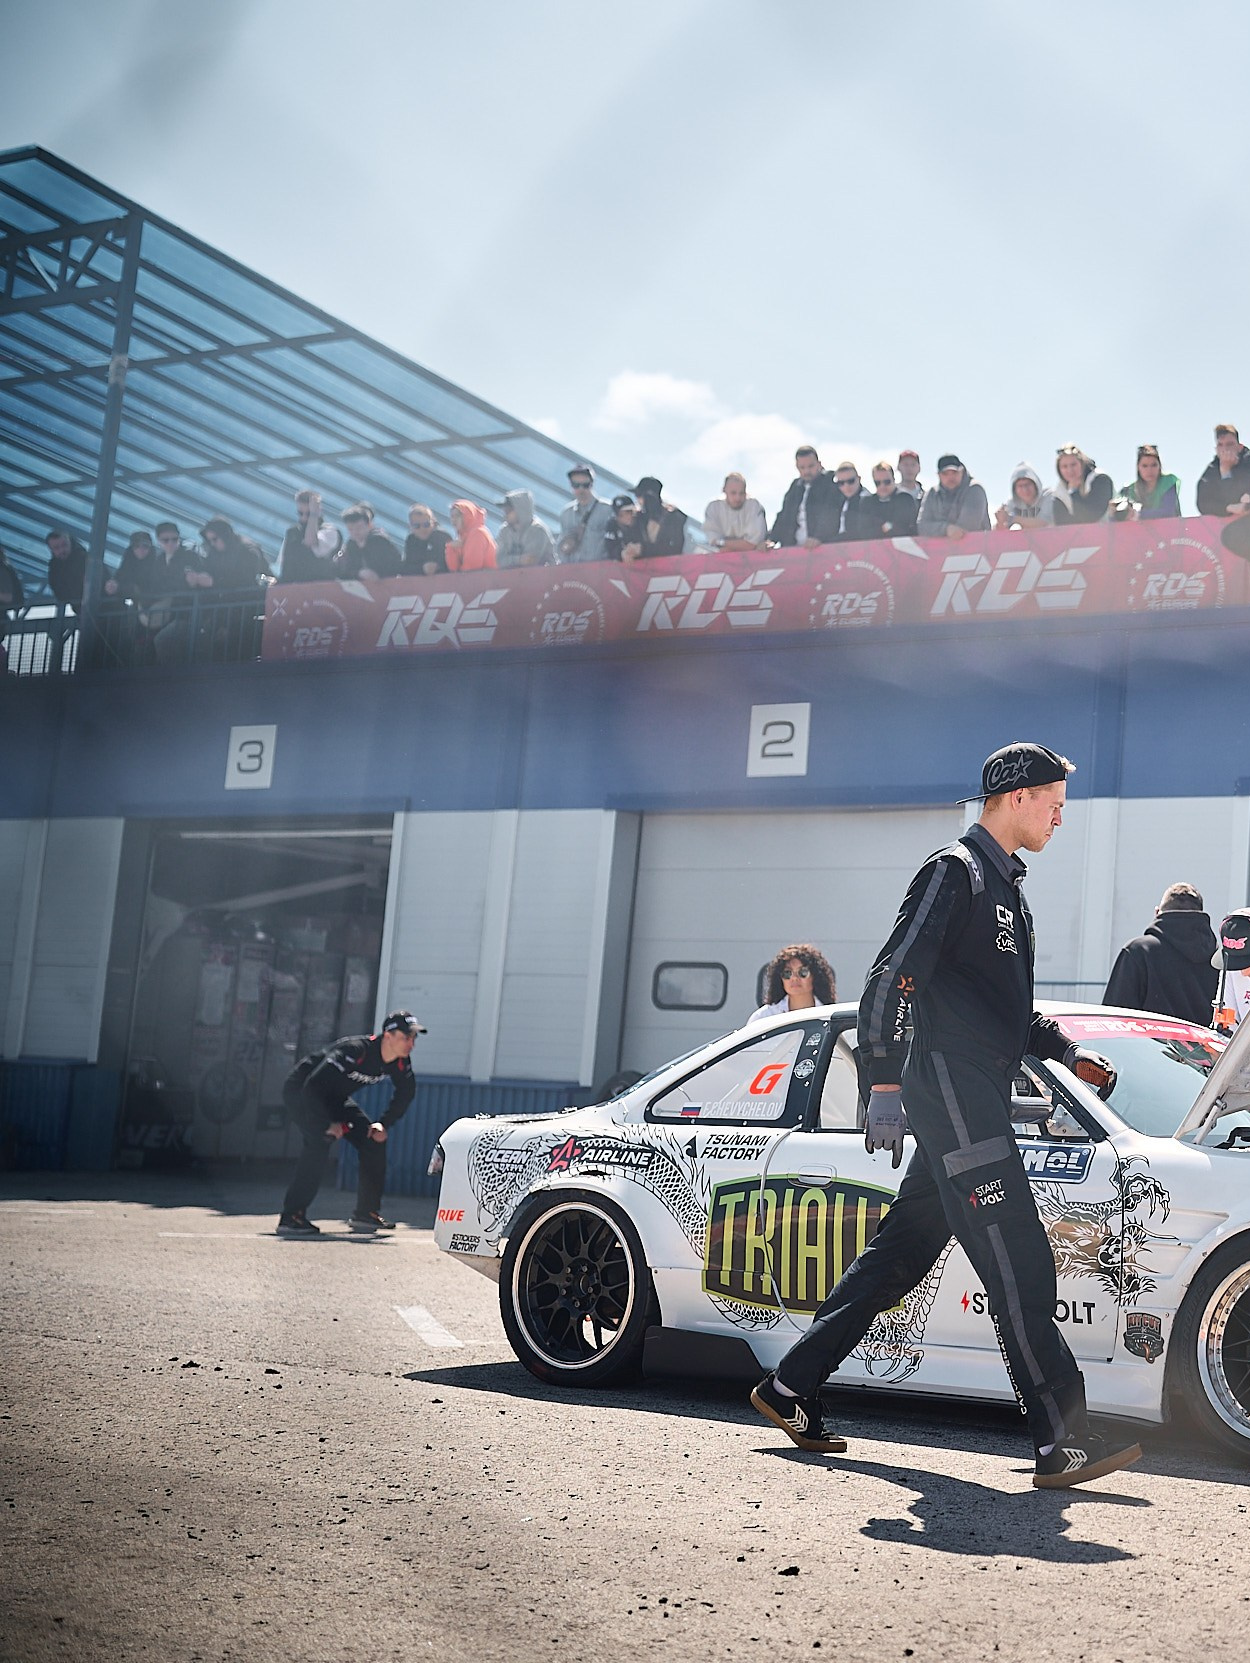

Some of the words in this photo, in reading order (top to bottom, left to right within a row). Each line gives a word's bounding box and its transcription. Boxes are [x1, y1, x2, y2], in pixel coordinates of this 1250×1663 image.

[929, 546, 1100, 615] RDS
[1142, 571, 1211, 599] RDS
[636, 568, 785, 631] RDS
[821, 591, 881, 615] RDS
[541, 609, 593, 633] RDS
[293, 626, 338, 648] RDS
[761, 720, 795, 758] 2
[236, 741, 264, 773] 3
[706, 1134, 772, 1146] TSUNAMI
[484, 1150, 530, 1164] OCEAN
[580, 1149, 652, 1166] AIRLINE
[700, 1146, 765, 1160] FACTORY
[975, 1179, 1003, 1197] START
[979, 1190, 1007, 1206] VOLT
[437, 1209, 465, 1223] RIVE
[449, 1241, 479, 1253] FACTORY
[451, 1233, 481, 1243] #STICKERS
